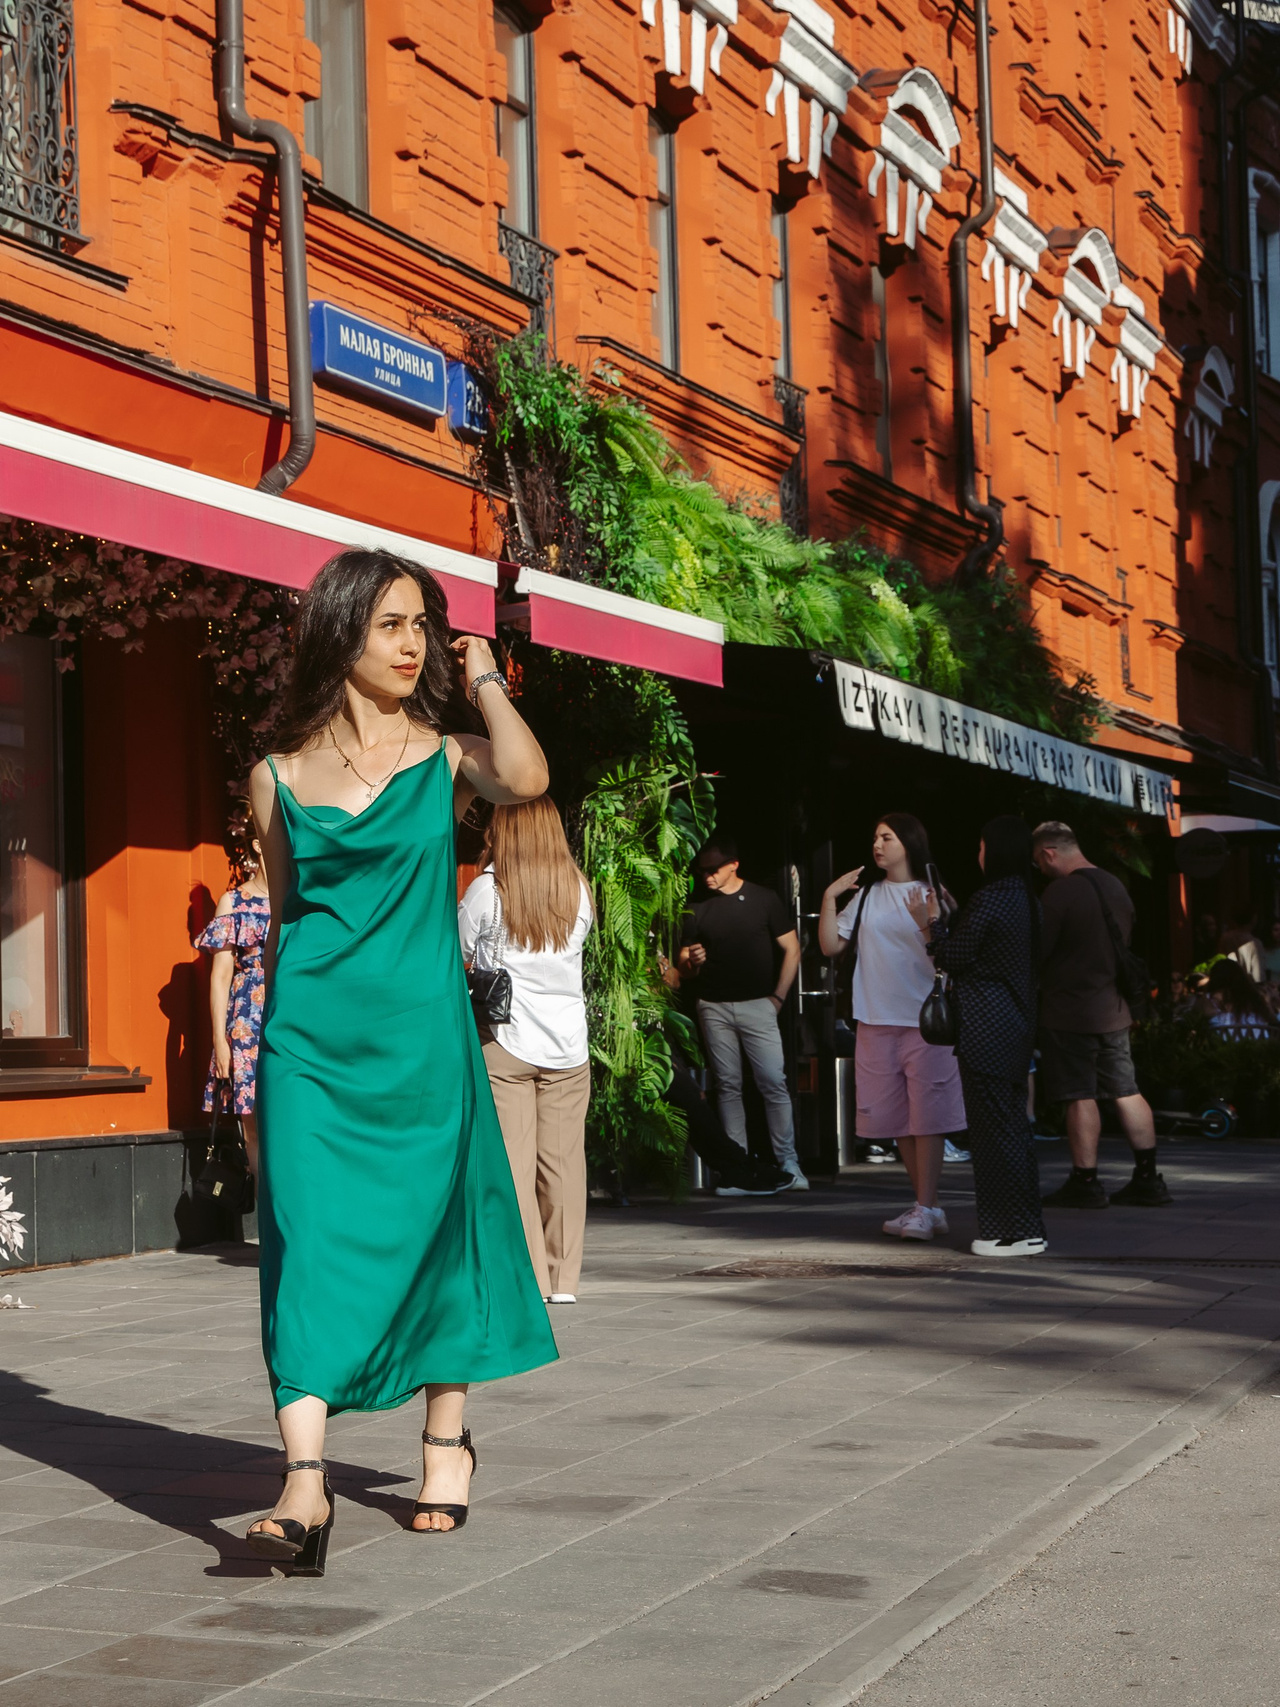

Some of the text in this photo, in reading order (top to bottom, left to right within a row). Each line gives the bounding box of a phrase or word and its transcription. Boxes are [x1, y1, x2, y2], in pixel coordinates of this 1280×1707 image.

[339, 324, 434, 383] МАЛАЯ БРОННАЯ
[374, 366, 401, 388] УЛИЦА
[842, 677, 926, 733] IZKAYA
